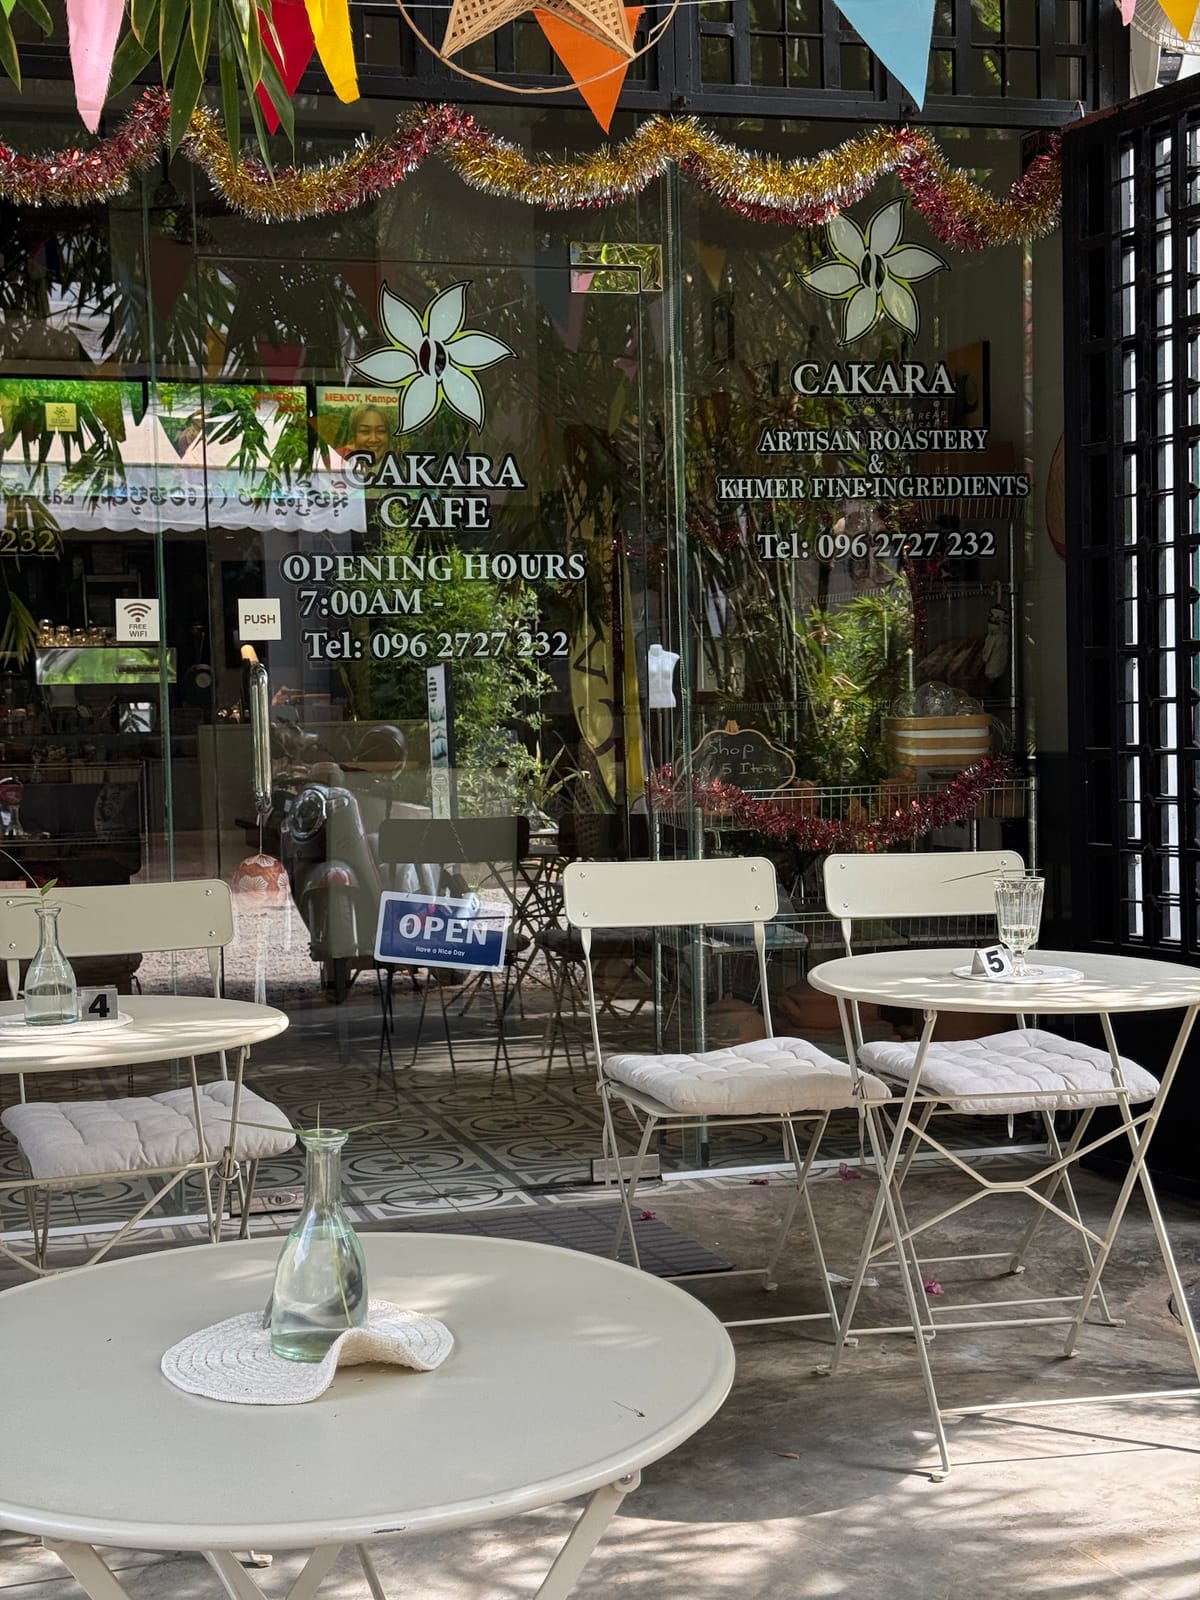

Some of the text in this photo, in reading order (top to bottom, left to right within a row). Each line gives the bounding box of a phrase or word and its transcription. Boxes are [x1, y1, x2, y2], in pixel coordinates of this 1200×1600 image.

[793, 364, 956, 394] CAKARA
[365, 393, 398, 405] Kampo
[760, 429, 988, 451] ARTISAN ROASTERY
[346, 453, 524, 488] CAKARA
[868, 453, 885, 474] &
[719, 478, 806, 499] KHMER
[874, 476, 1029, 498] INGREDIENTS
[380, 497, 490, 528] CAFE
[0, 529, 56, 552] 232
[757, 532, 995, 559] Tel: 096 2727 232
[283, 553, 585, 582] OPENING HOURS
[300, 588, 423, 616] 7:00AM
[243, 615, 276, 625] PUSH
[129, 630, 147, 638] WIFI
[305, 631, 569, 659] Tel: 096 2727 232
[709, 736, 755, 760] Shop
[399, 913, 489, 946] OPEN
[453, 949, 466, 957] Day
[986, 950, 1004, 973] 5
[88, 994, 110, 1017] 4
